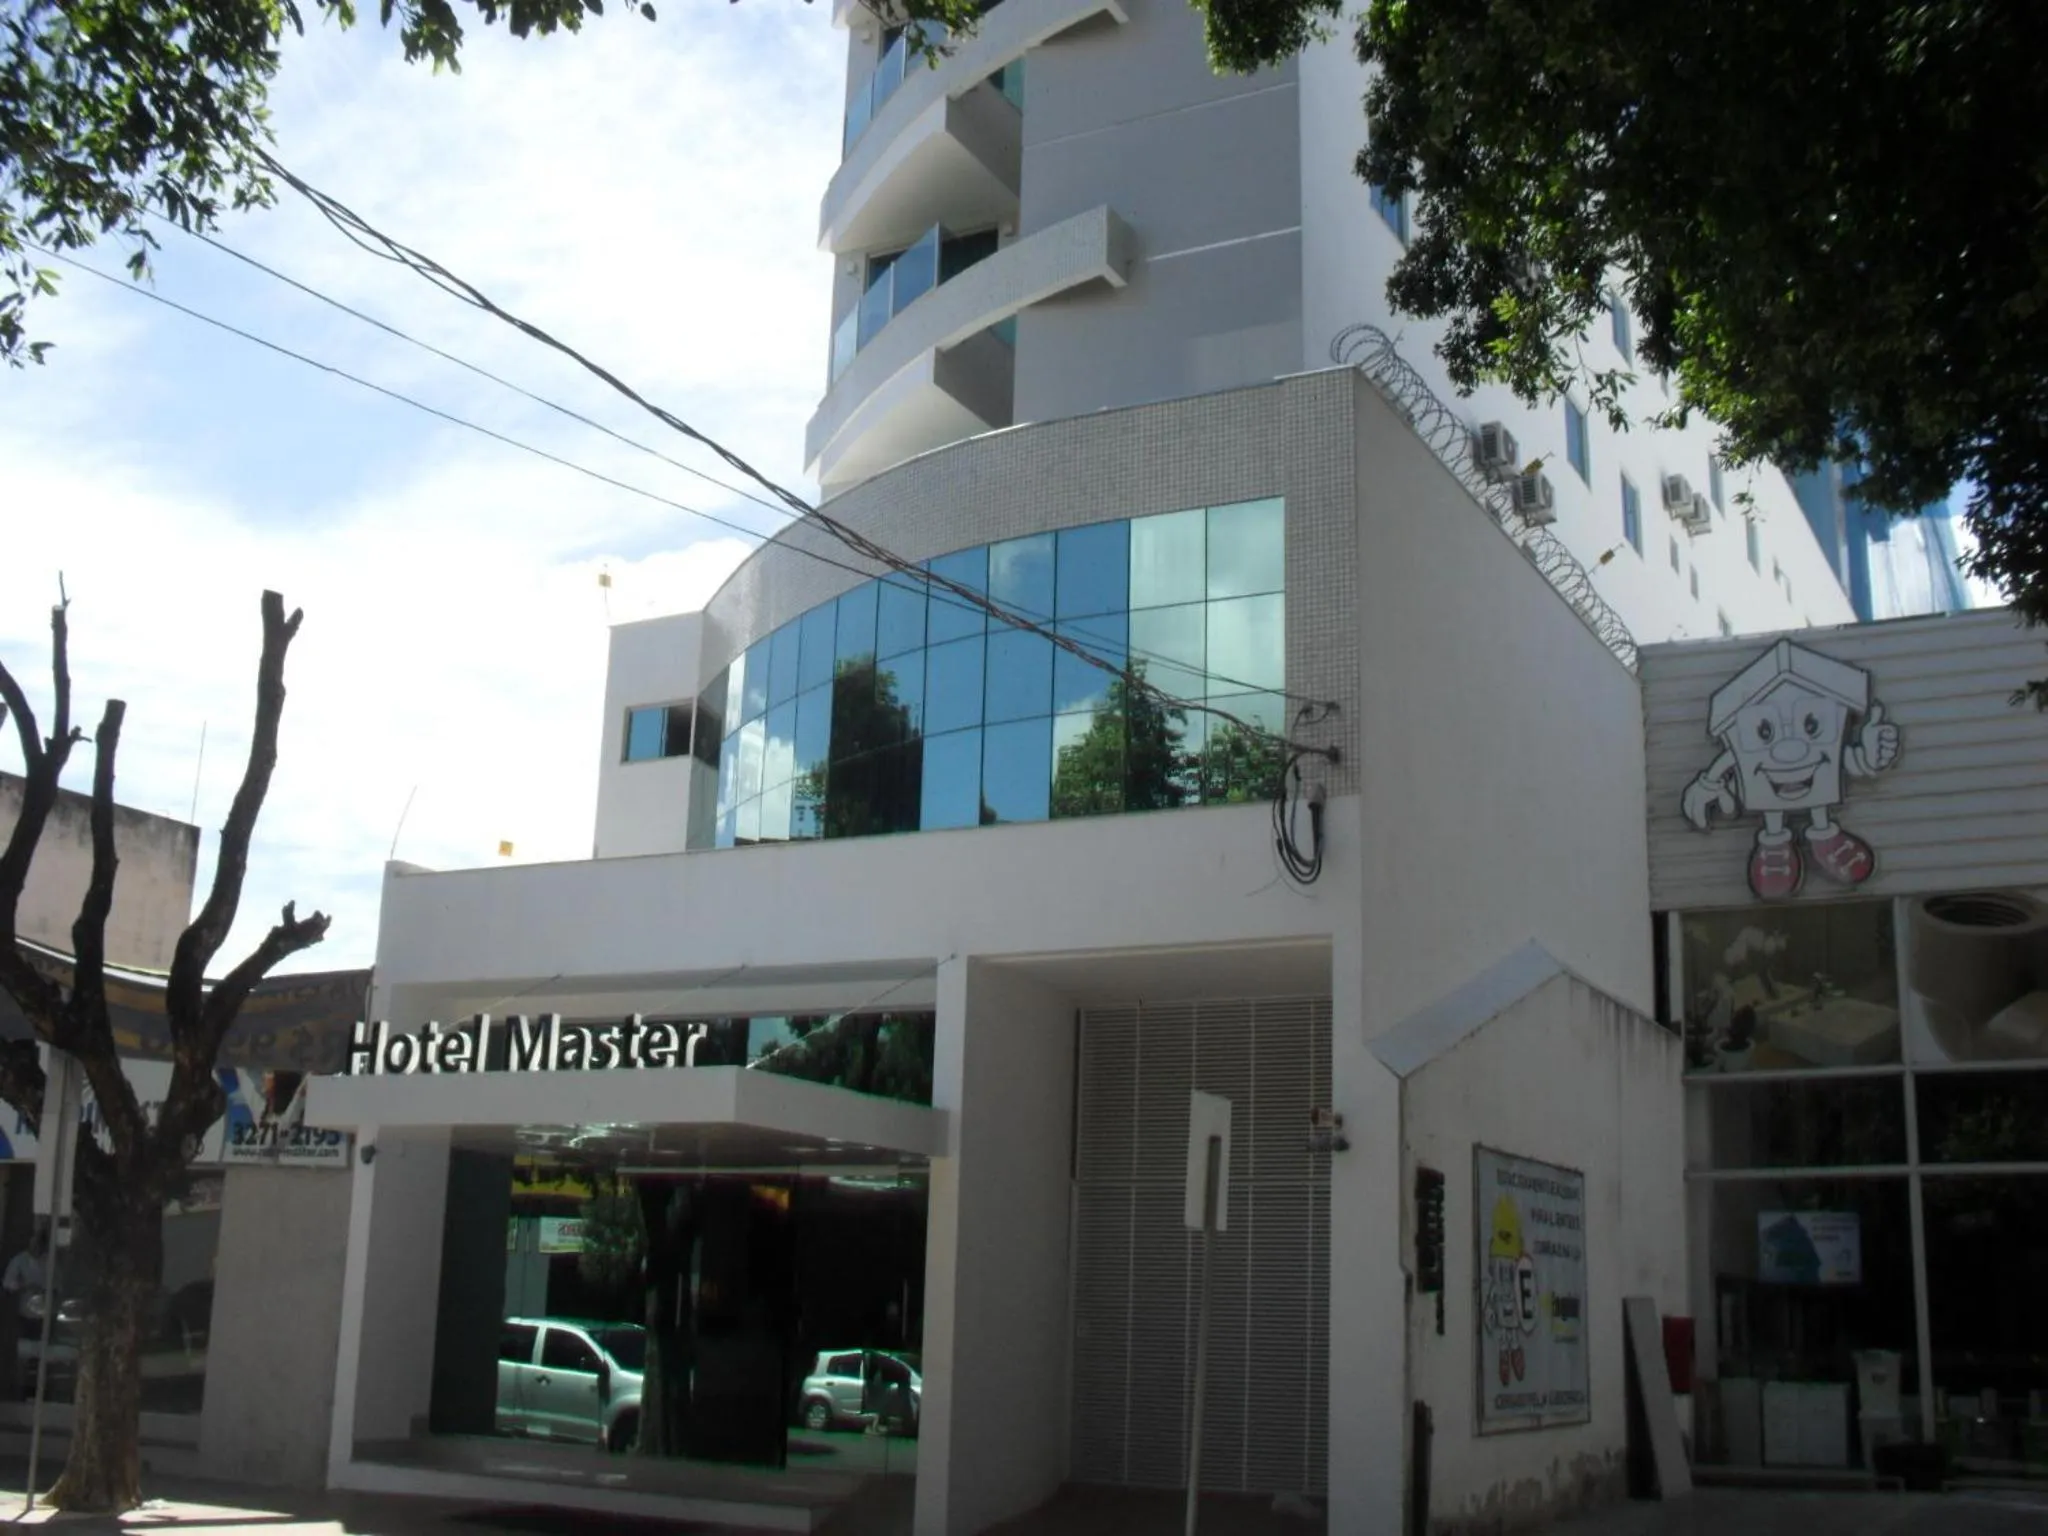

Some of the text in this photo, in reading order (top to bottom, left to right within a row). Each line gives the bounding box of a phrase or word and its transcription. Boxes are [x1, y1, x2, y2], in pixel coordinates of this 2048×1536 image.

[348, 1014, 491, 1074] Hotel
[505, 1013, 707, 1072] Master
[1519, 1269, 1532, 1319] E
